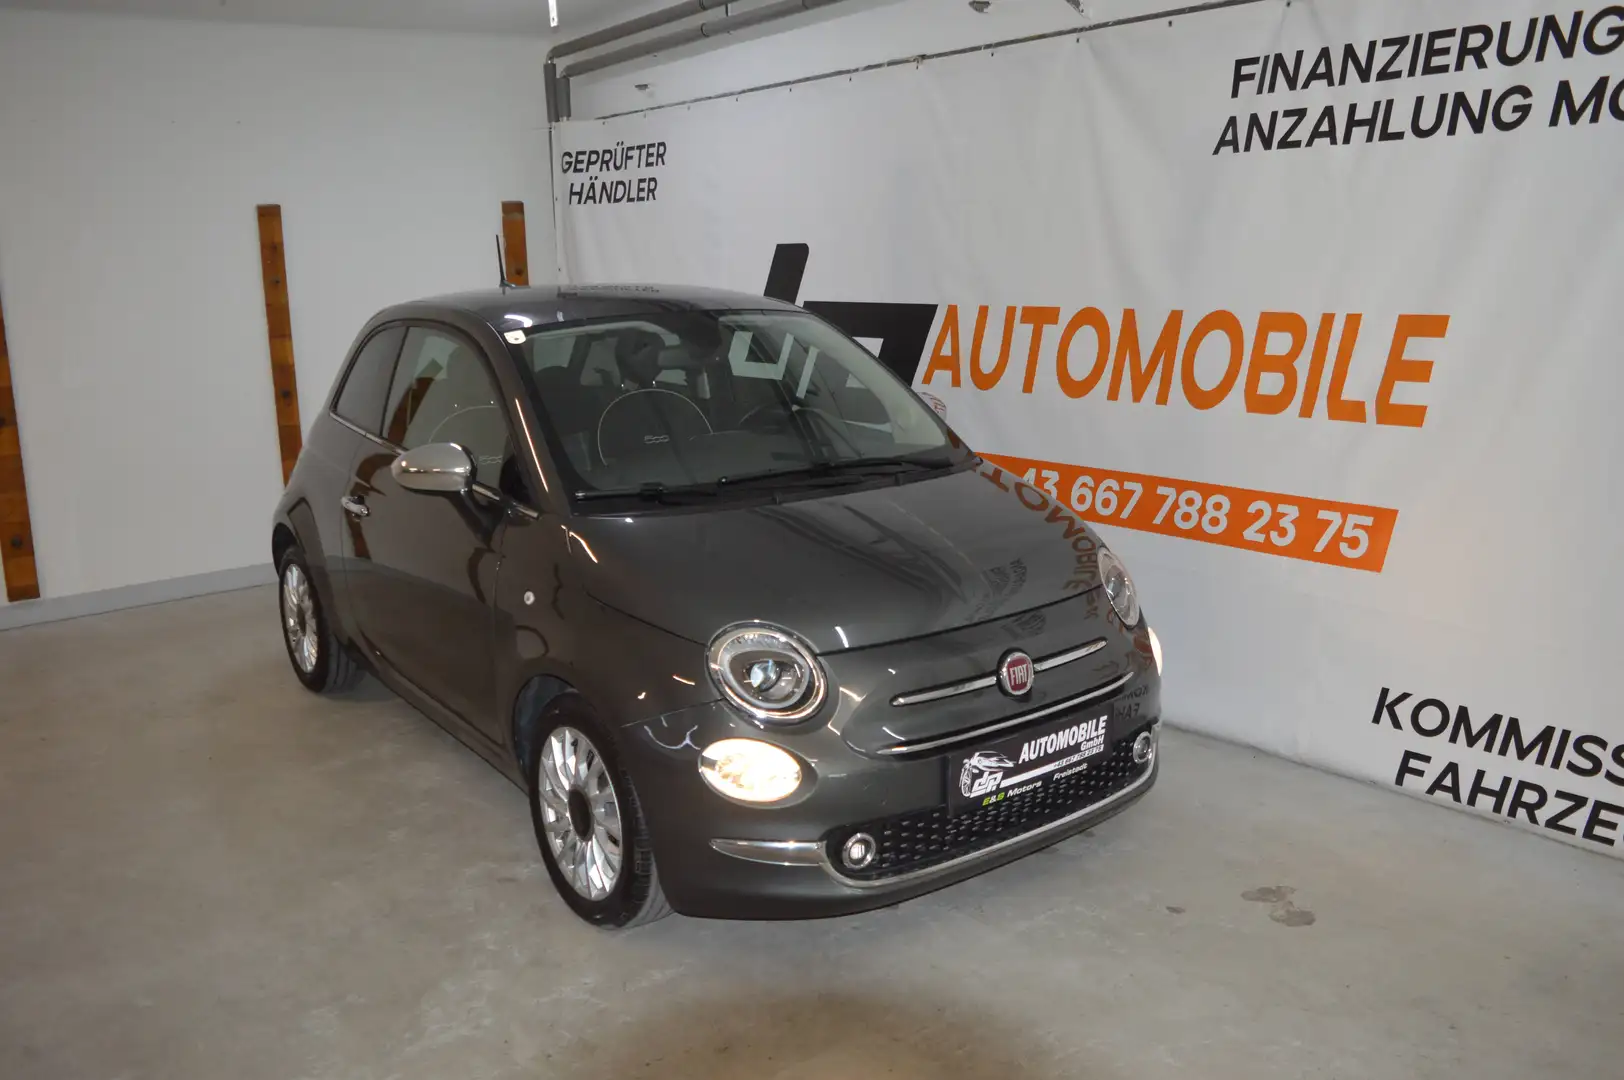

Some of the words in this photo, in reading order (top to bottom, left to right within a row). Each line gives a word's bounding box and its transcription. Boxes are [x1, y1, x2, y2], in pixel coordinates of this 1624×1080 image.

[1231, 5, 1624, 99] FINANZIERUNG
[1212, 84, 1533, 156] ANZAHLUNG
[561, 141, 667, 174] GEPRÜFTER
[569, 175, 658, 205] HÄNDLER
[921, 304, 1451, 428] AUTOMOBILE
[1070, 475, 1143, 519] 667
[1152, 485, 1231, 534] 788
[1242, 500, 1299, 547] 23
[1313, 509, 1374, 559] 75
[1009, 663, 1028, 686] FIAT
[1018, 715, 1108, 765] AUTOMOBILE
[1080, 735, 1104, 751] GmbH
[1007, 780, 1042, 798] Motors
[1395, 749, 1624, 847] FAHRZE
